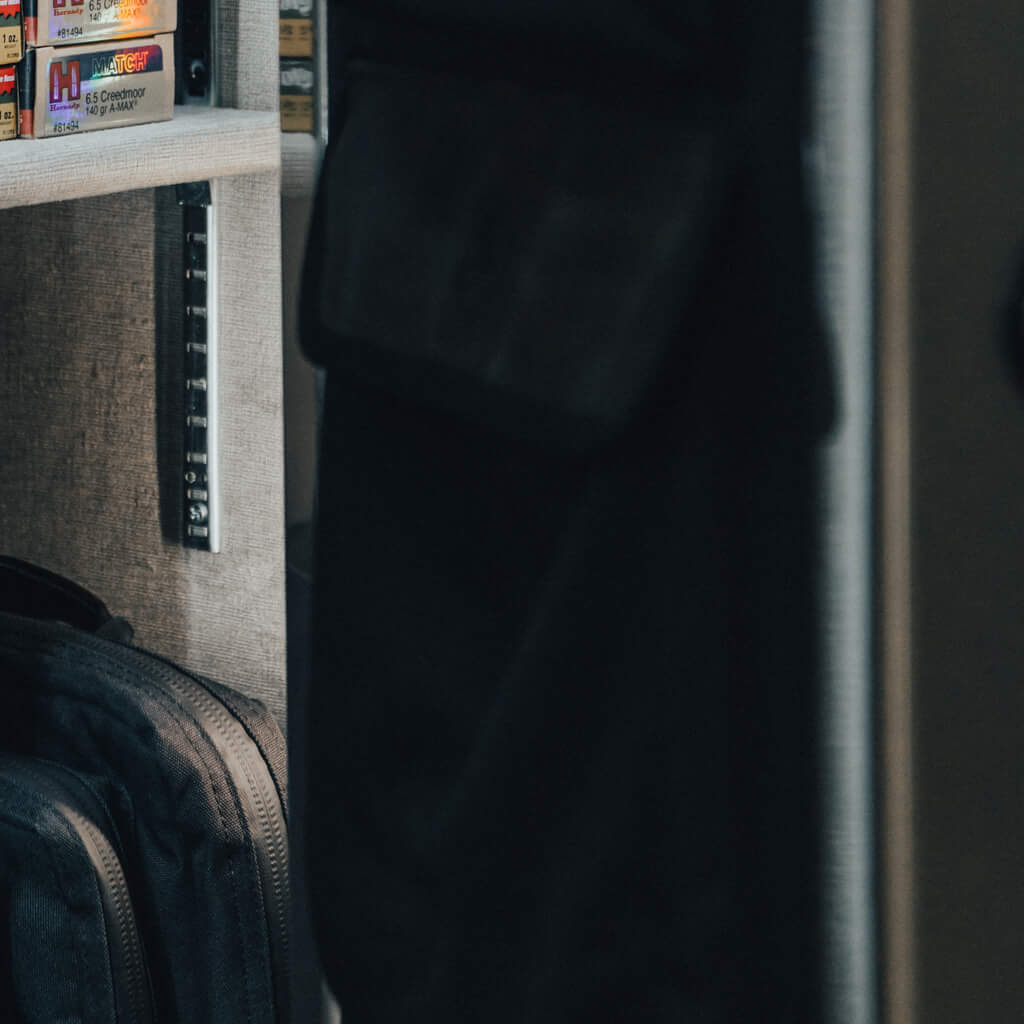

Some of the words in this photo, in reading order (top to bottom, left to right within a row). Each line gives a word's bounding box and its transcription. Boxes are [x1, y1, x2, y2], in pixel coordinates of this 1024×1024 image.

[88, 0, 102, 12] 6.5
[57, 27, 83, 39] #81494
[92, 51, 149, 77] MATCH
[85, 92, 98, 105] 6.5
[100, 86, 146, 102] Creedmoor
[85, 105, 98, 115] 140
[99, 105, 107, 117] gr
